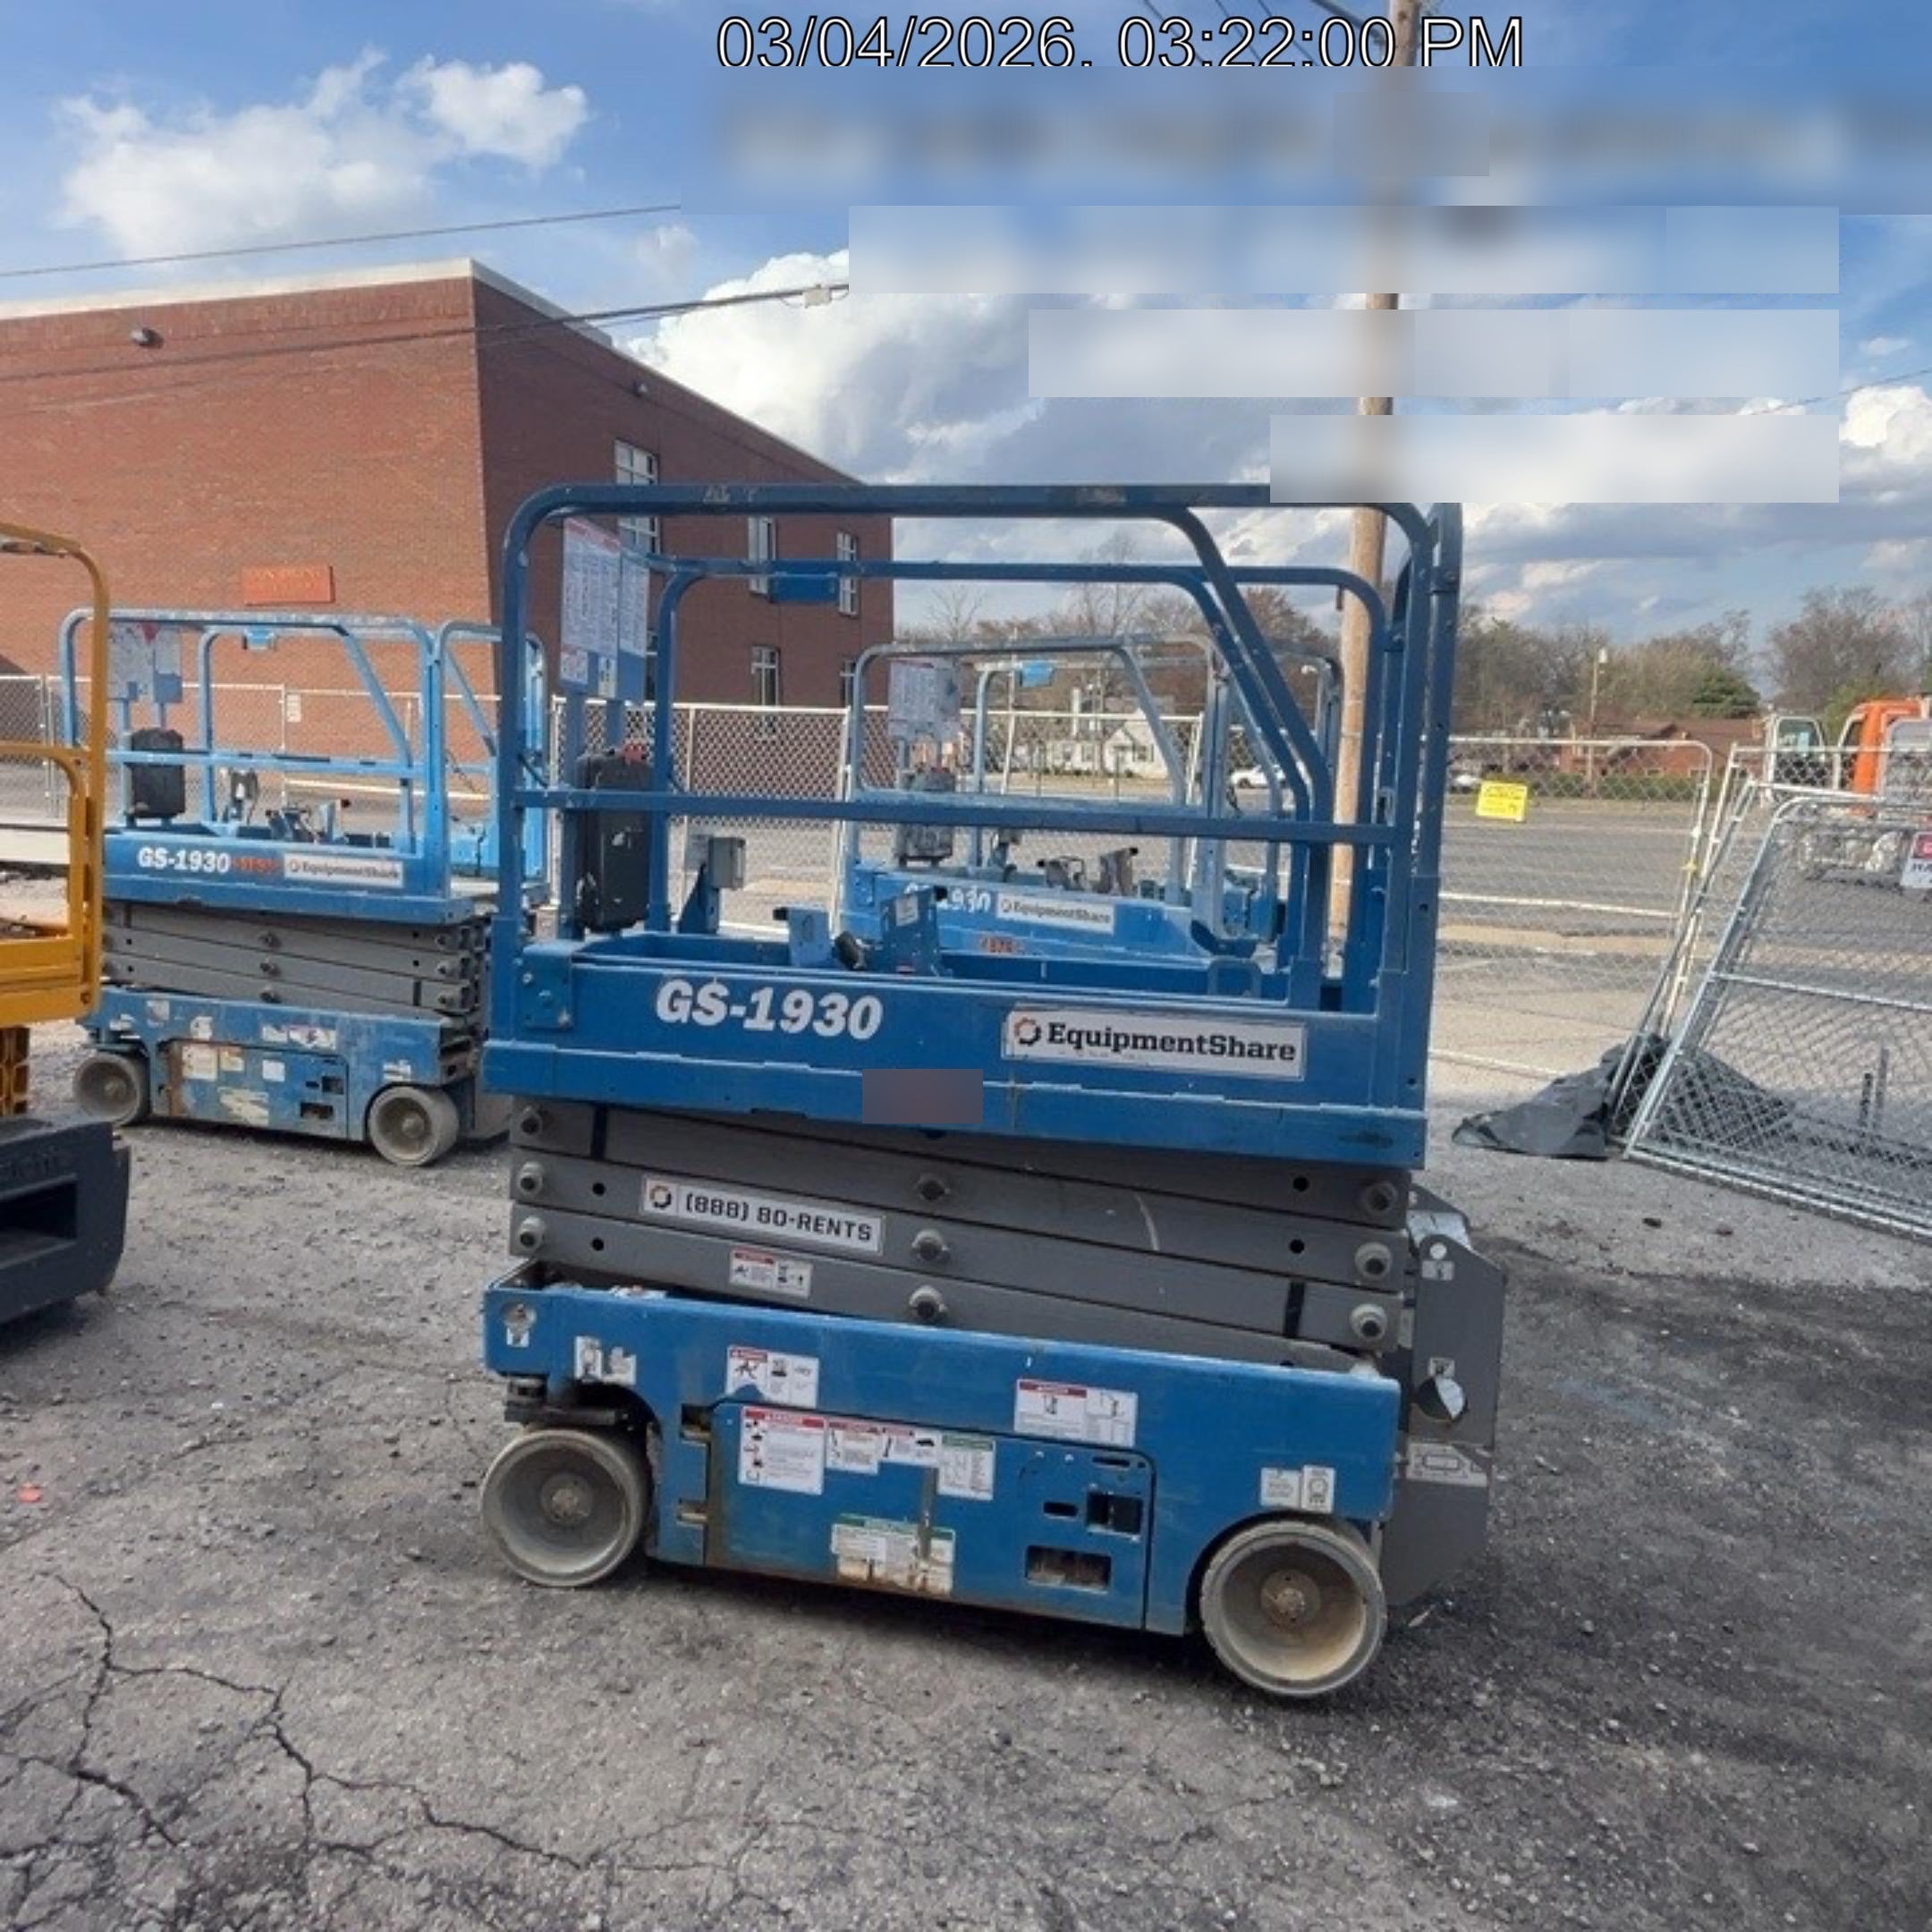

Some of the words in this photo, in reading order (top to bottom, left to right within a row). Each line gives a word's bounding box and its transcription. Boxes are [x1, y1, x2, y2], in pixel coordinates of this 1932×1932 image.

[138, 846, 231, 874] GS-1930
[656, 978, 884, 1040] GS-1930
[1047, 1021, 1296, 1061] EquipmentShare
[685, 1192, 750, 1222] (888)
